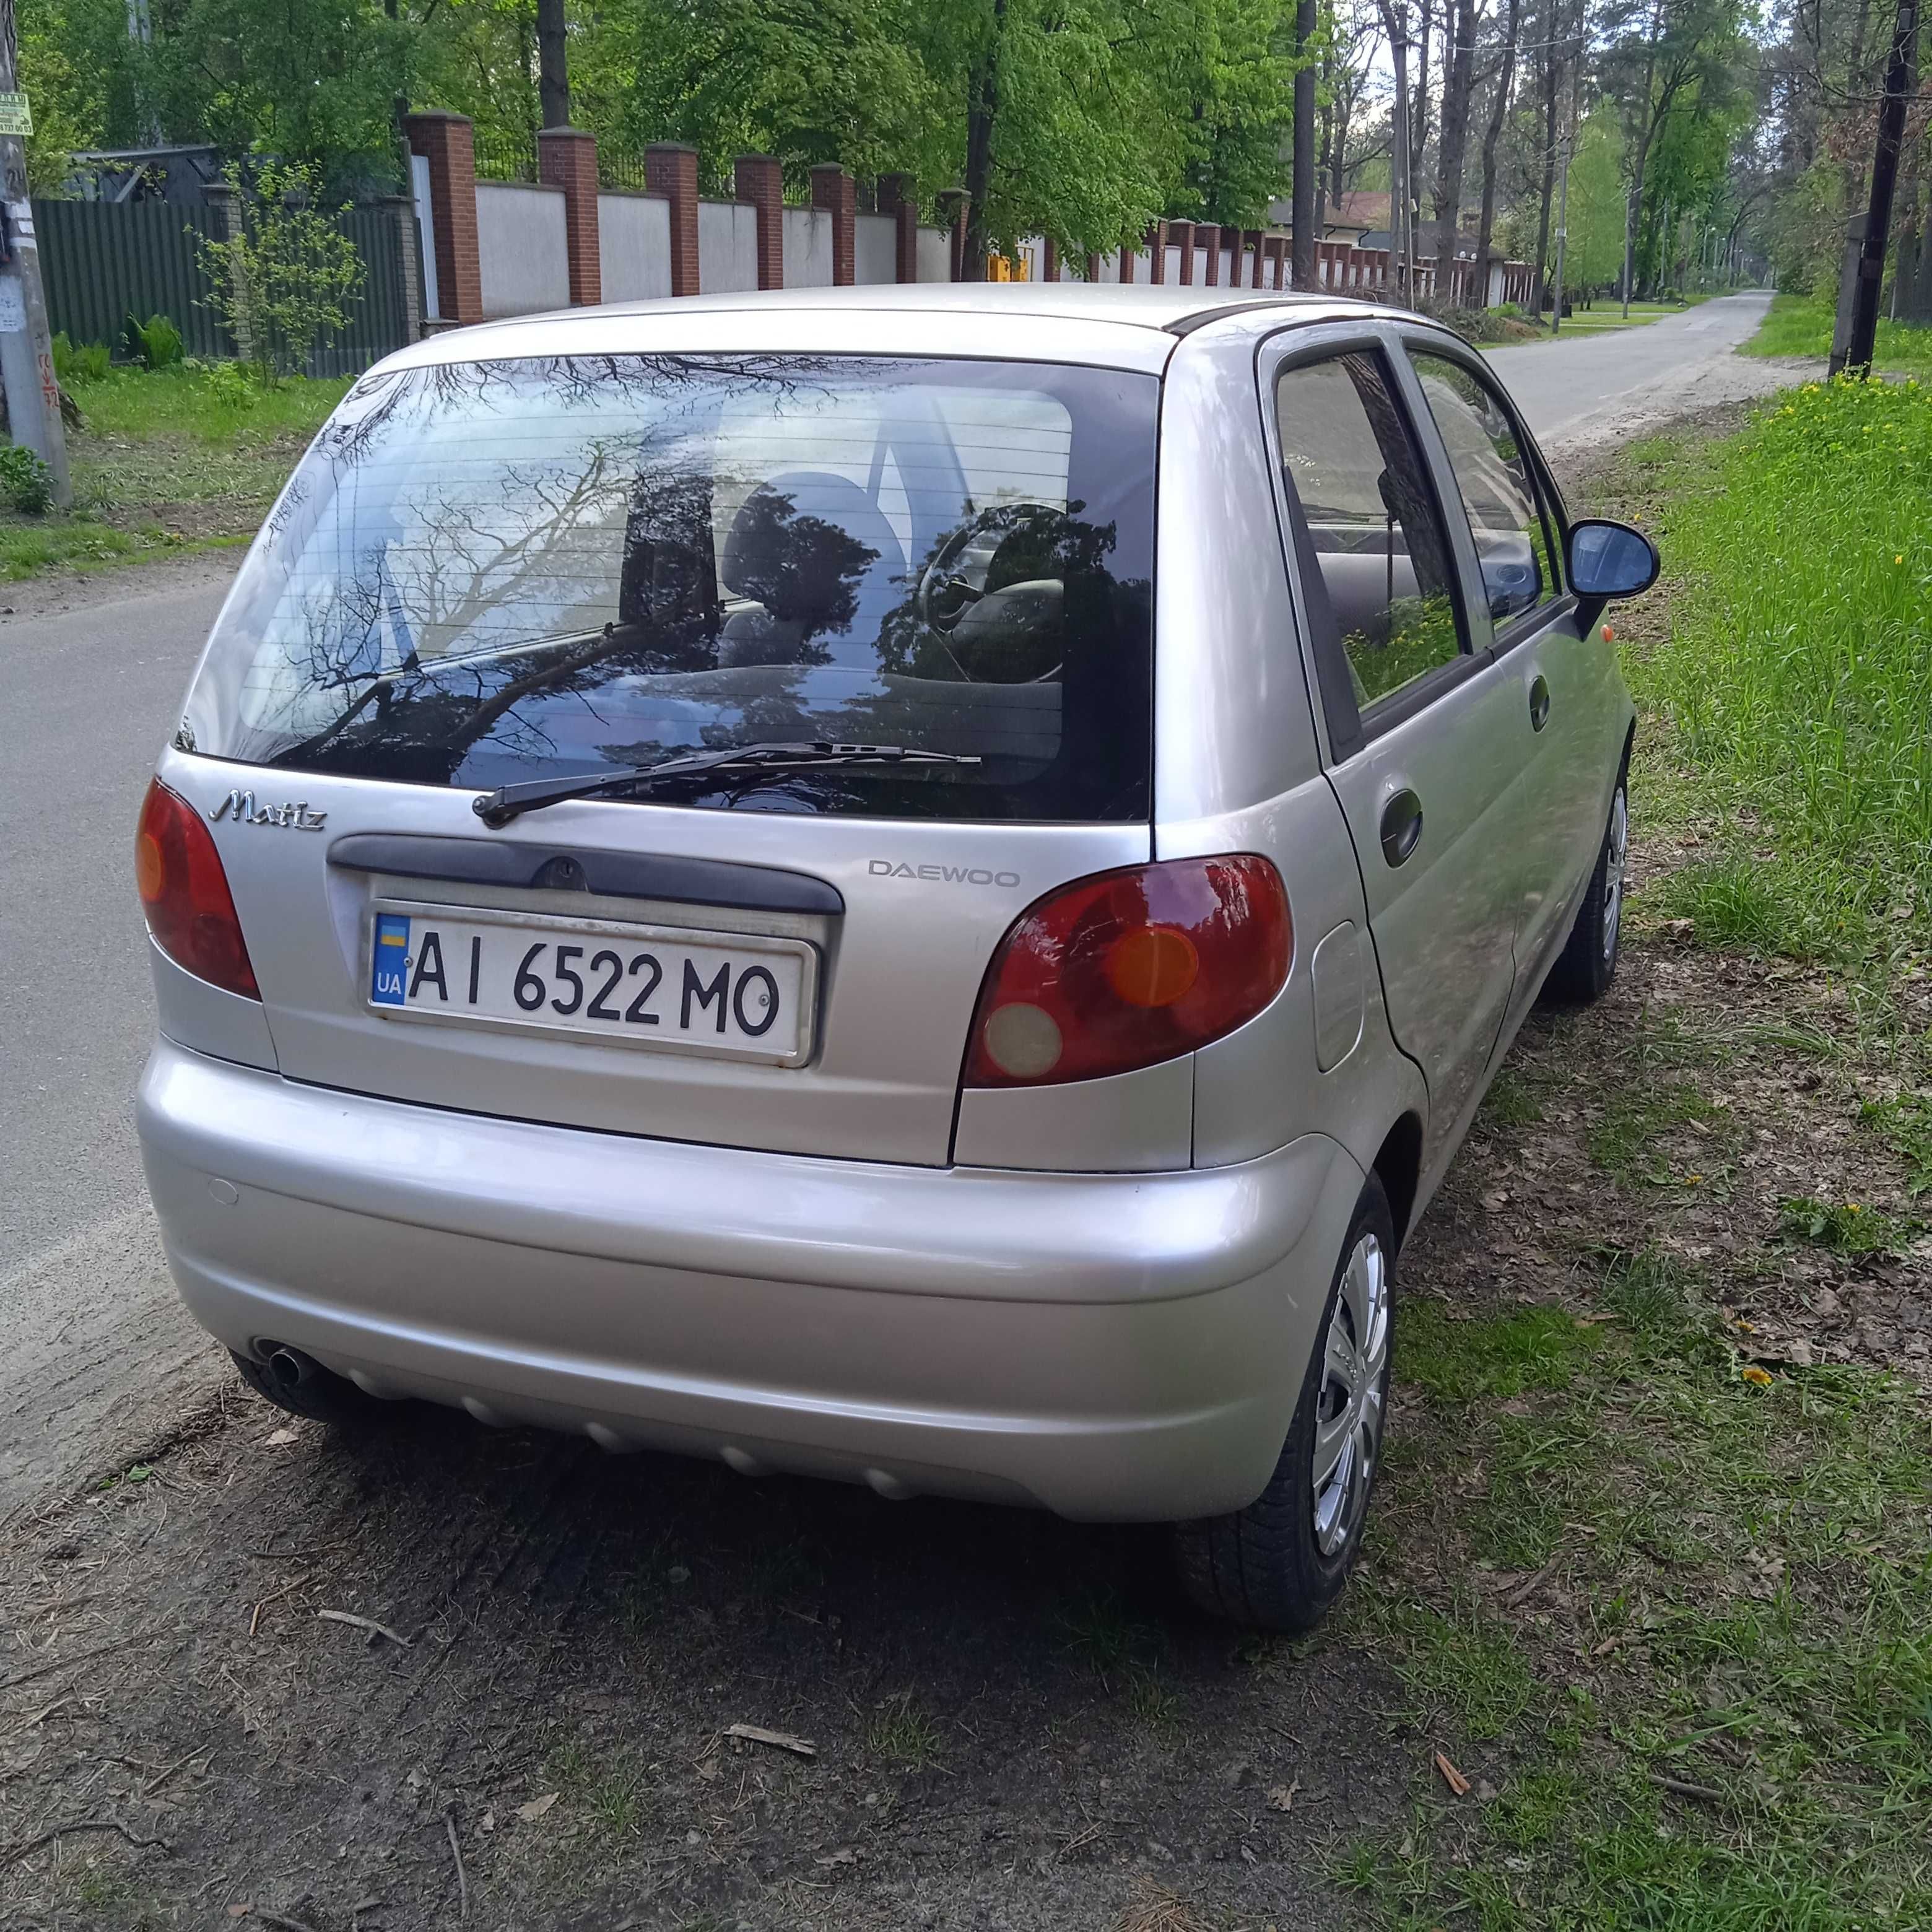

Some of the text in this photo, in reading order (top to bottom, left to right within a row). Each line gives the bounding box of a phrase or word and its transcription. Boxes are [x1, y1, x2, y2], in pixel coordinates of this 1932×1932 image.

[208, 788, 328, 831] Matiz
[868, 859, 1021, 887] DAEWOO
[377, 972, 402, 994] UA
[514, 943, 663, 1025] 6522
[681, 958, 780, 1037] MO
